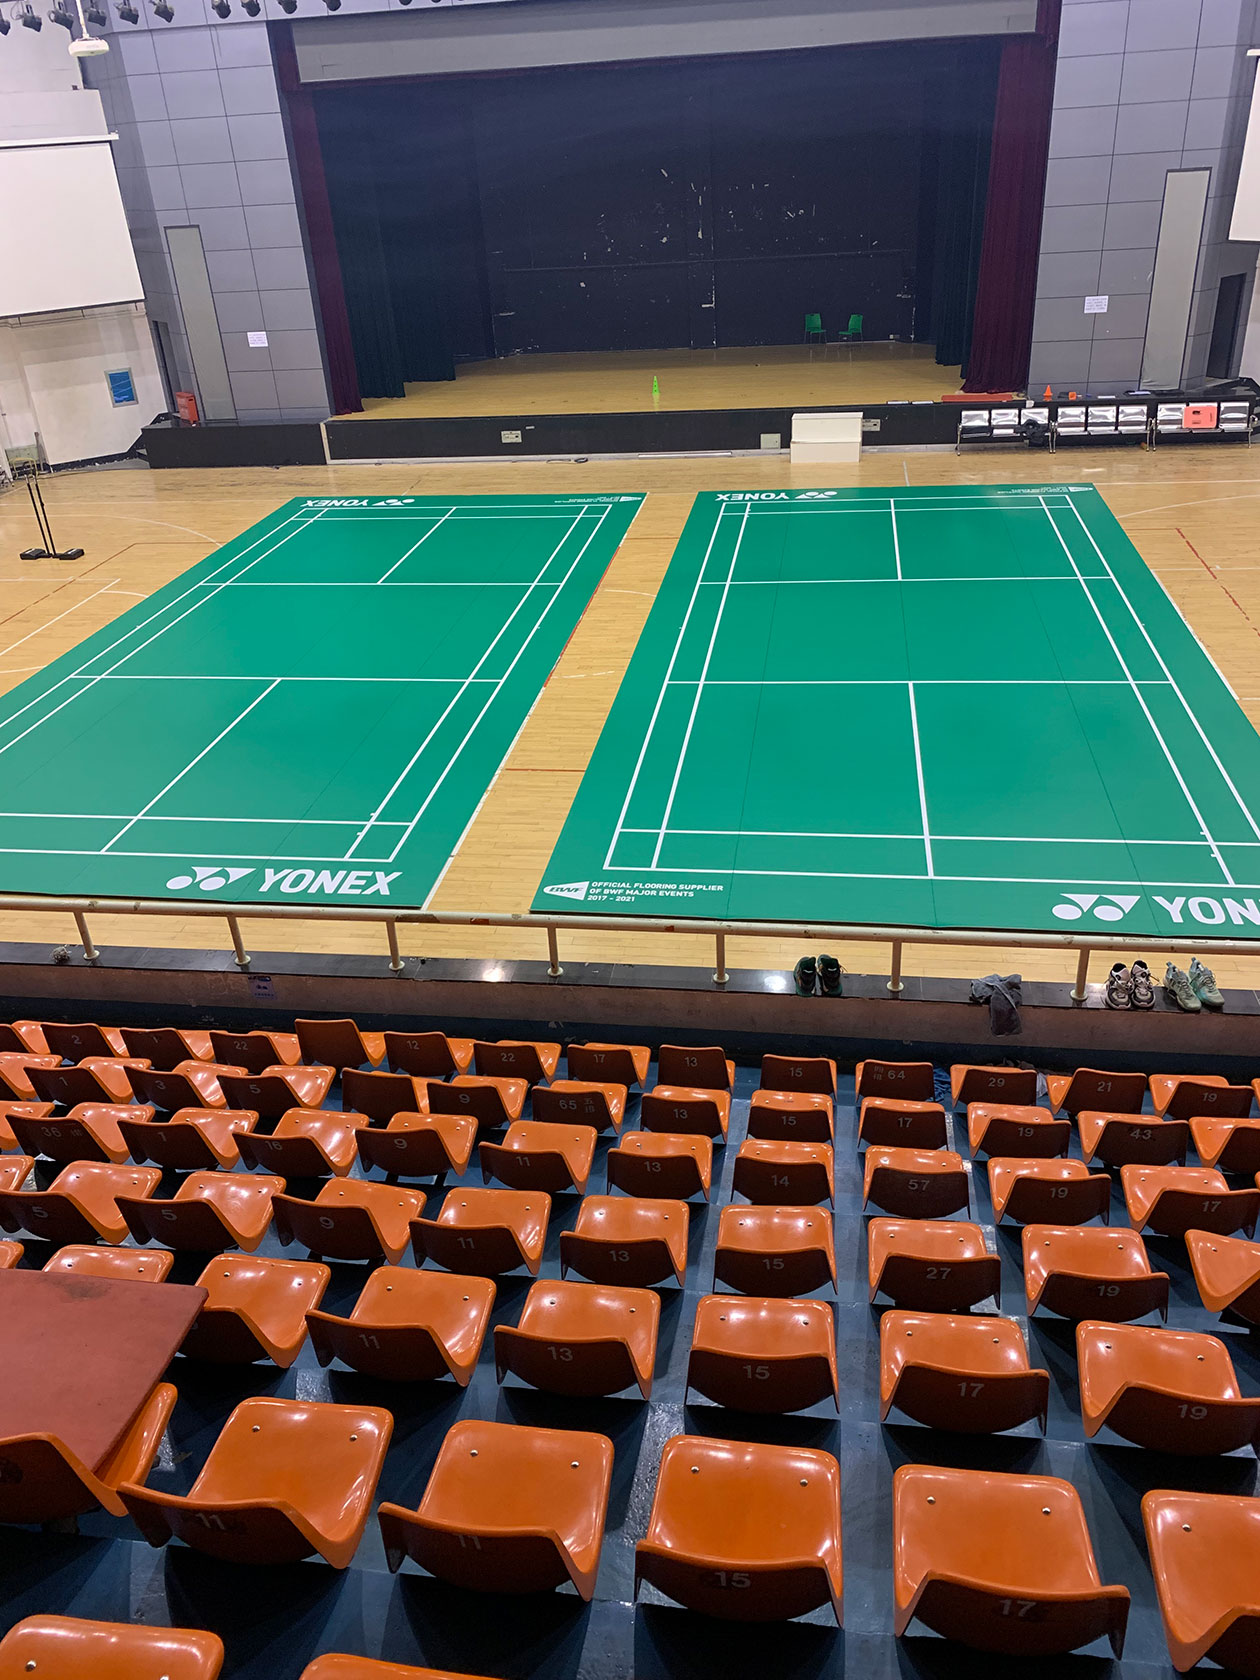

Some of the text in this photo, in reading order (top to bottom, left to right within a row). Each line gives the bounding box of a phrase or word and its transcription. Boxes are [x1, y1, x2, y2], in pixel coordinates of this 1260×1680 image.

[715, 492, 790, 501] YONEX
[300, 499, 369, 507] YONEX
[258, 868, 403, 895] YONEX
[1152, 896, 1260, 925] YON
[71, 1034, 82, 1044] 2
[234, 1041, 248, 1050] 22
[406, 1040, 420, 1050] 12
[501, 1052, 516, 1062] 22
[593, 1054, 606, 1063] 17
[684, 1056, 698, 1067] 13
[790, 1067, 803, 1077] 15
[888, 1070, 905, 1080] 64
[59, 1076, 68, 1086] 1
[155, 1080, 166, 1090] 3
[988, 1077, 1005, 1087] 29
[1097, 1081, 1112, 1092] 21
[249, 1084, 261, 1094] 5
[459, 1093, 470, 1104] 9
[1203, 1092, 1217, 1102] 19
[559, 1099, 577, 1110] 65
[673, 1108, 688, 1119] 13
[781, 1116, 796, 1126] 15
[898, 1117, 913, 1128] 17
[41, 1126, 62, 1137] 36
[157, 1131, 167, 1142] 1
[1018, 1127, 1034, 1137] 19
[1130, 1128, 1152, 1140] 43
[394, 1138, 407, 1149] 9
[516, 1156, 530, 1166] 11
[644, 1161, 661, 1172] 13
[771, 1175, 789, 1187] 14
[908, 1179, 930, 1191] 57
[1050, 1187, 1068, 1198] 19
[32, 1206, 48, 1218] 5
[1202, 1201, 1222, 1212] 17
[161, 1209, 177, 1220] 5
[319, 1216, 334, 1229] 9
[457, 1237, 475, 1249] 11
[609, 1250, 630, 1262] 13
[762, 1258, 784, 1270] 15
[926, 1267, 951, 1279] 27
[1097, 1285, 1120, 1297] 19
[359, 1334, 380, 1349] 11
[547, 1346, 573, 1361] 13
[743, 1365, 770, 1379] 15
[958, 1382, 984, 1397] 17
[1178, 1404, 1208, 1420] 19
[195, 1512, 226, 1530] 11
[714, 1571, 751, 1588] 15
[1000, 1599, 1036, 1617] 17
